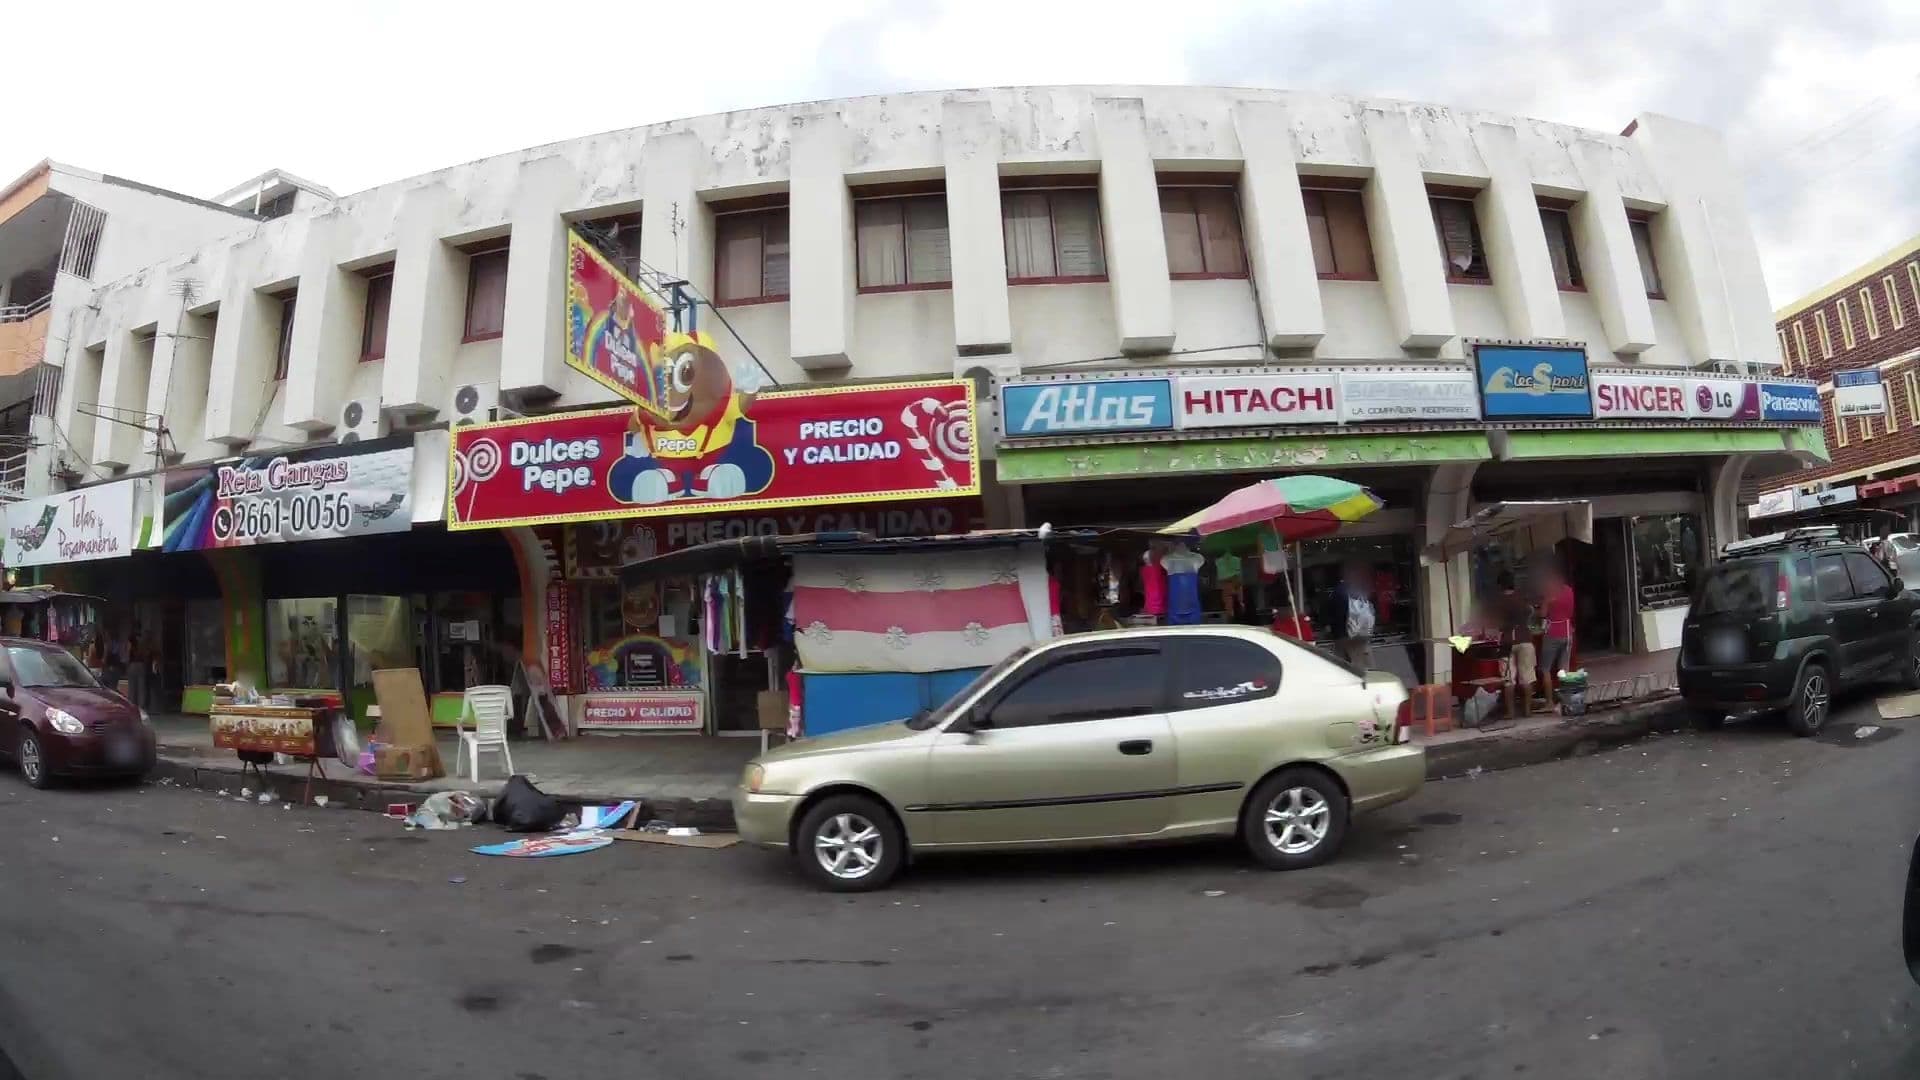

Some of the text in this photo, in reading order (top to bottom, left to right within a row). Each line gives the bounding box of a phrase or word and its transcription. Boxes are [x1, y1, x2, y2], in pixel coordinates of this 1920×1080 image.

[1021, 385, 1156, 432] Atlas
[1184, 387, 1334, 415] HITACHI
[1597, 384, 1684, 412] SINGER
[1716, 392, 1733, 409] LG
[1762, 391, 1820, 413] Panasonic
[800, 417, 883, 440] PRECIO
[511, 438, 600, 466] Dulces
[657, 437, 697, 452] Pepe
[783, 441, 901, 466] Y CALIDAD
[218, 457, 349, 498] Reta Gangas
[523, 466, 591, 494] Pepe
[68, 494, 97, 533] Telas
[234, 493, 350, 537] 2661-0056
[667, 516, 779, 546] PRECIO
[815, 507, 953, 536] CALIDAD
[586, 706, 692, 718] PRECIO Y CALIDAD
